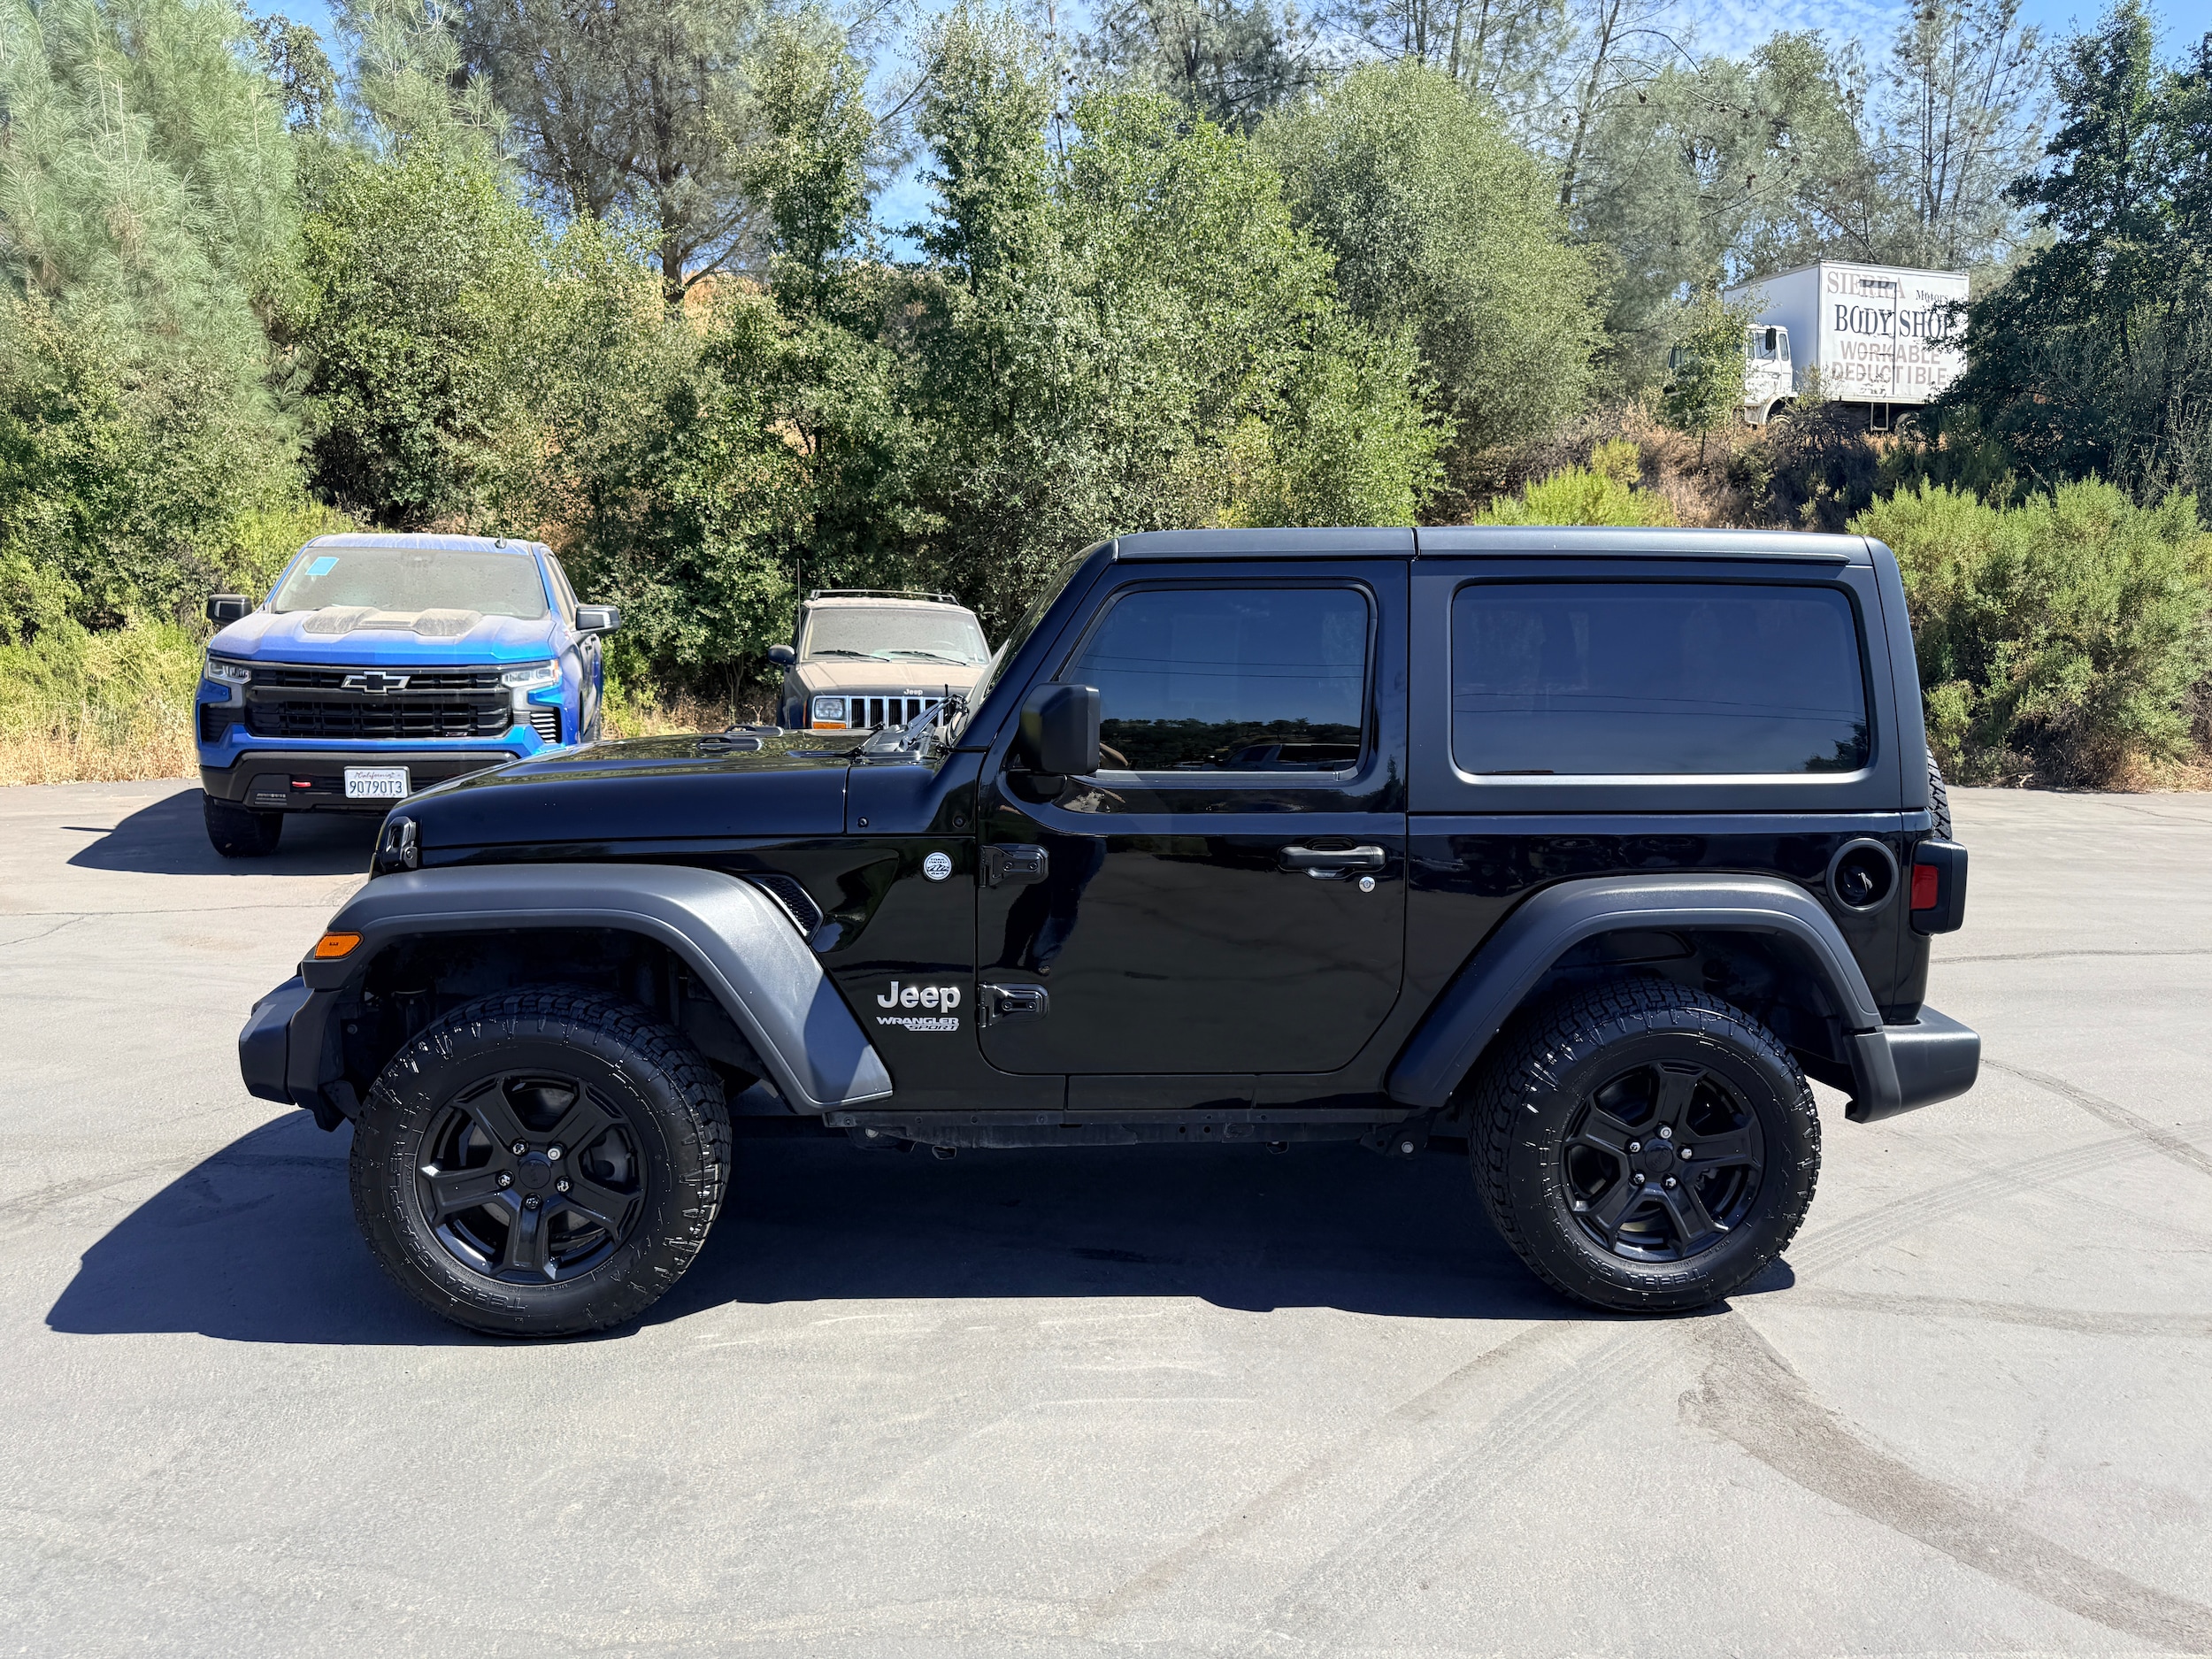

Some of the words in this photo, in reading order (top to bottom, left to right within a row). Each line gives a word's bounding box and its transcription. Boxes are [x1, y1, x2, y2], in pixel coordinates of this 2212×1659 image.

[1827, 271, 1906, 299] SIERRA
[1834, 304, 1893, 335] BODY
[1840, 341, 1940, 365] WORKABLE
[1832, 362, 1947, 386] DEDUCTIBLE
[349, 780, 403, 794] 90790T3
[356, 771, 395, 780] California
[877, 981, 961, 1014] Jeep
